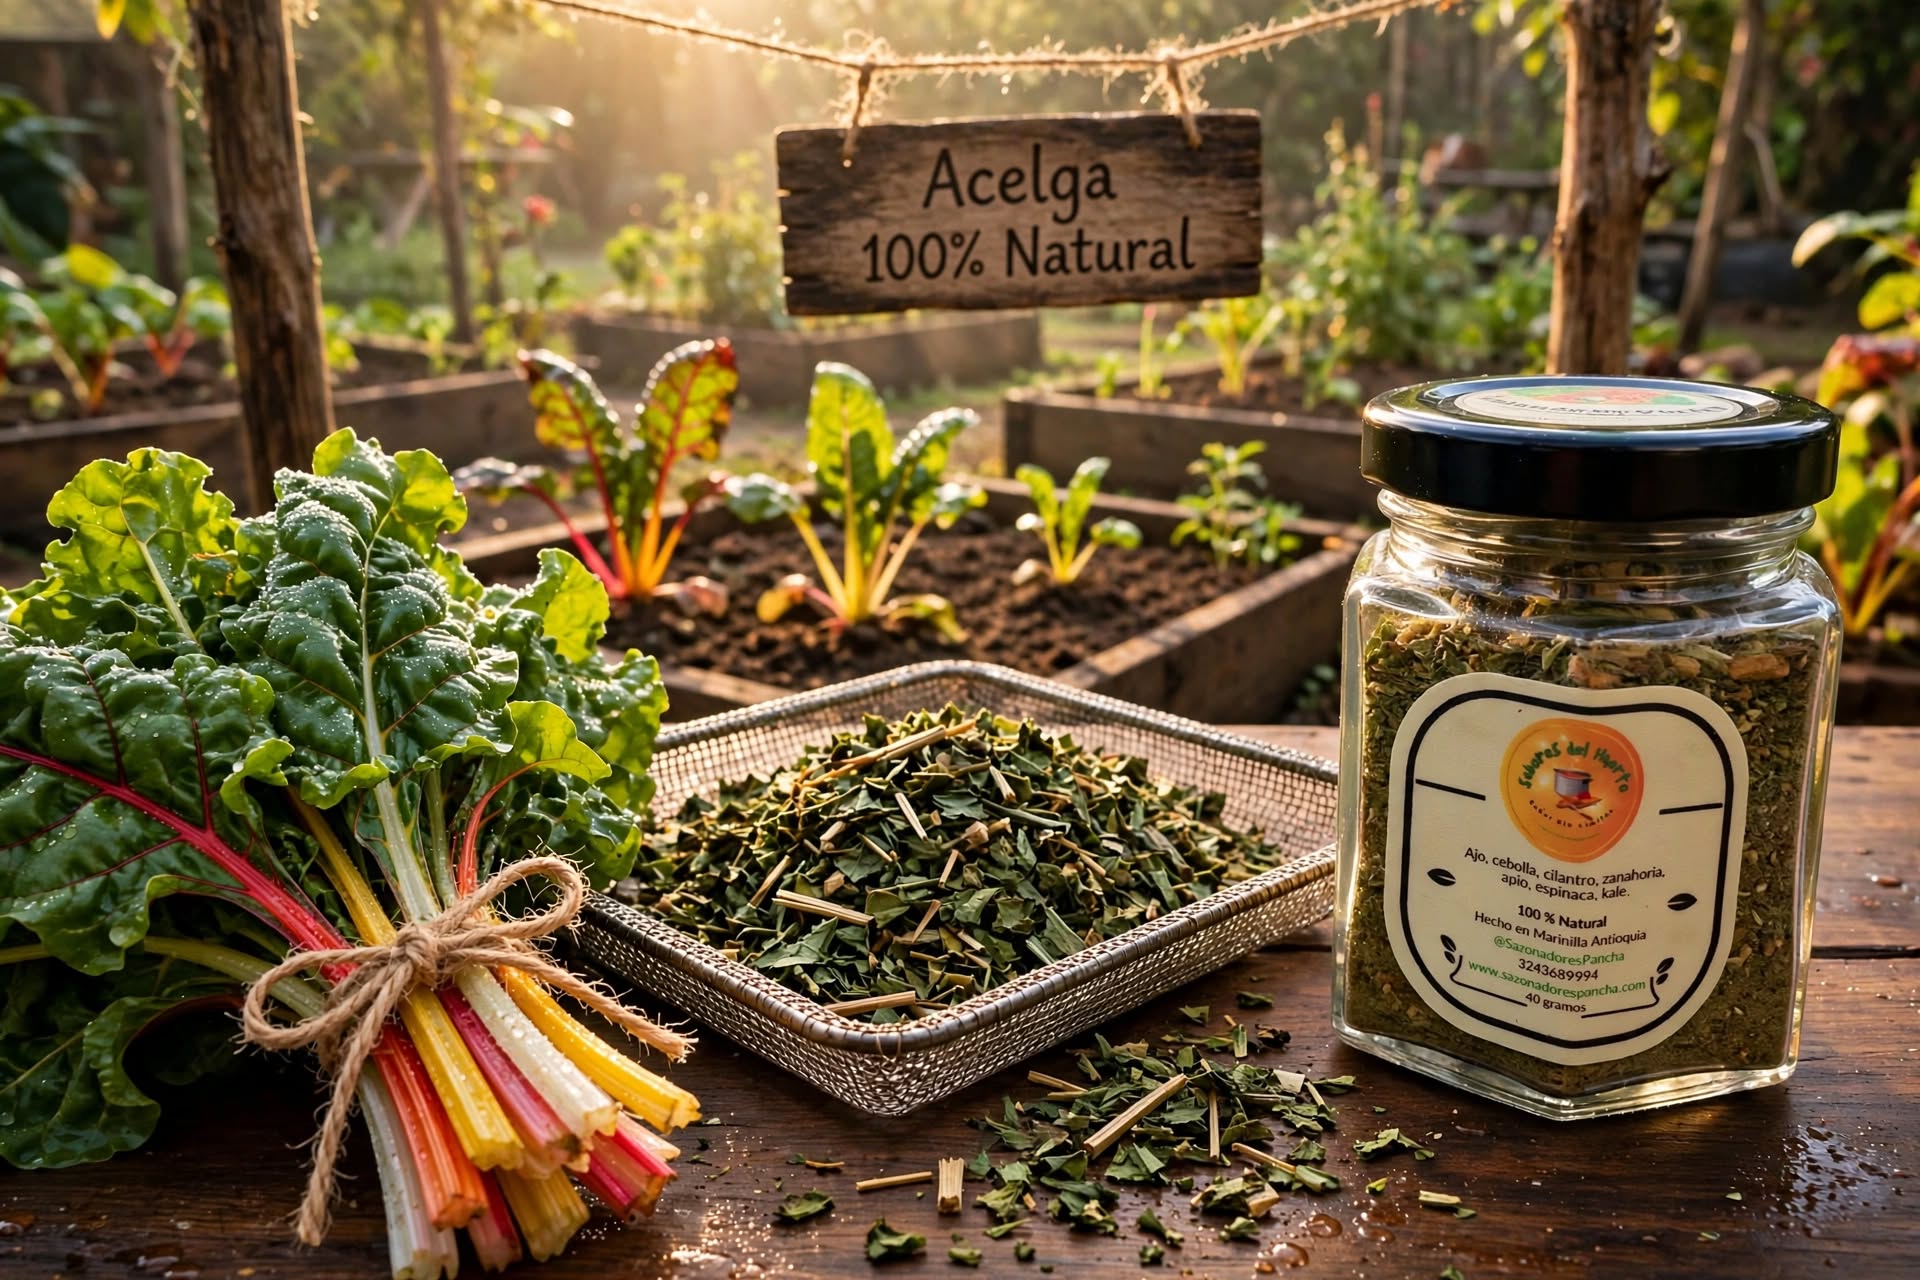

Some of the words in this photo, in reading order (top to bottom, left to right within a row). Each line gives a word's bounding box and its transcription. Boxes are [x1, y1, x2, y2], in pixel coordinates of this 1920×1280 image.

[922, 142, 1118, 225] Acelga
[861, 229, 984, 283] 100%
[1005, 216, 1197, 278] Natural
[1566, 741, 1591, 758] del
[1464, 847, 1489, 864] Ajo,
[1492, 855, 1540, 879] cebolla,
[1543, 869, 1600, 887] cilantro,
[1501, 872, 1532, 891] apio,
[1535, 883, 1598, 901] espinaca,
[1601, 885, 1631, 900] kale.
[1474, 910, 1512, 931] Hecho
[1515, 924, 1530, 936] en
[1533, 928, 1588, 948] Marinilla
[1590, 930, 1647, 947] Antioquia
[1518, 904, 1541, 920] 100
[1543, 911, 1556, 925] %
[1559, 915, 1608, 930] Natural
[1494, 935, 1625, 966] @SazonadoresPancha
[1468, 960, 1646, 1000] www.sazonadorespancha.com
[1518, 958, 1599, 982] 3243689994
[1525, 992, 1541, 1005] 40
[1543, 997, 1587, 1013] gramos
